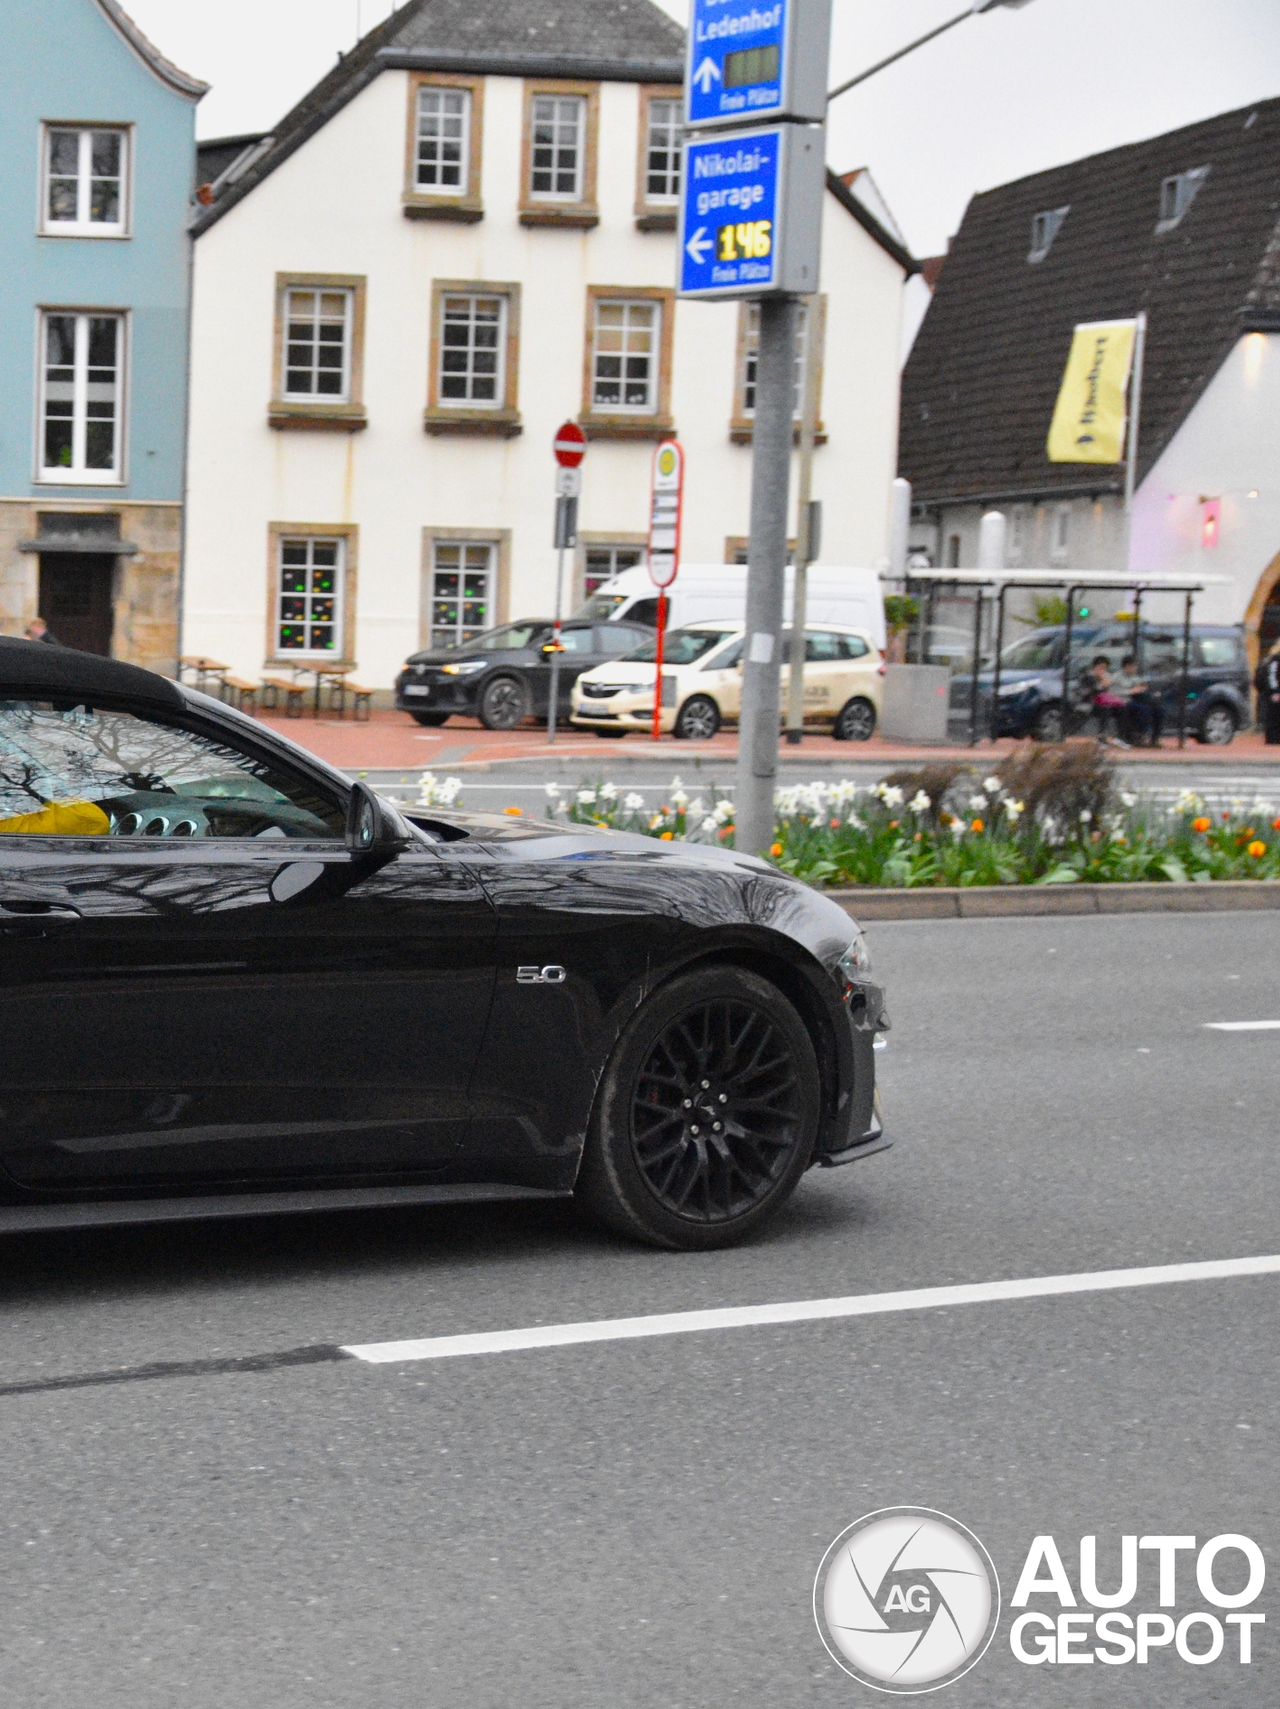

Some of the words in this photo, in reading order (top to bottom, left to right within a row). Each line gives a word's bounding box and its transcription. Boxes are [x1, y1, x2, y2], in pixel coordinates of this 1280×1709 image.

[696, 3, 782, 42] Ledenhof
[694, 147, 770, 180] Nikolai-
[696, 184, 764, 215] garage
[719, 220, 772, 261] 146
[516, 965, 567, 984] 5.0
